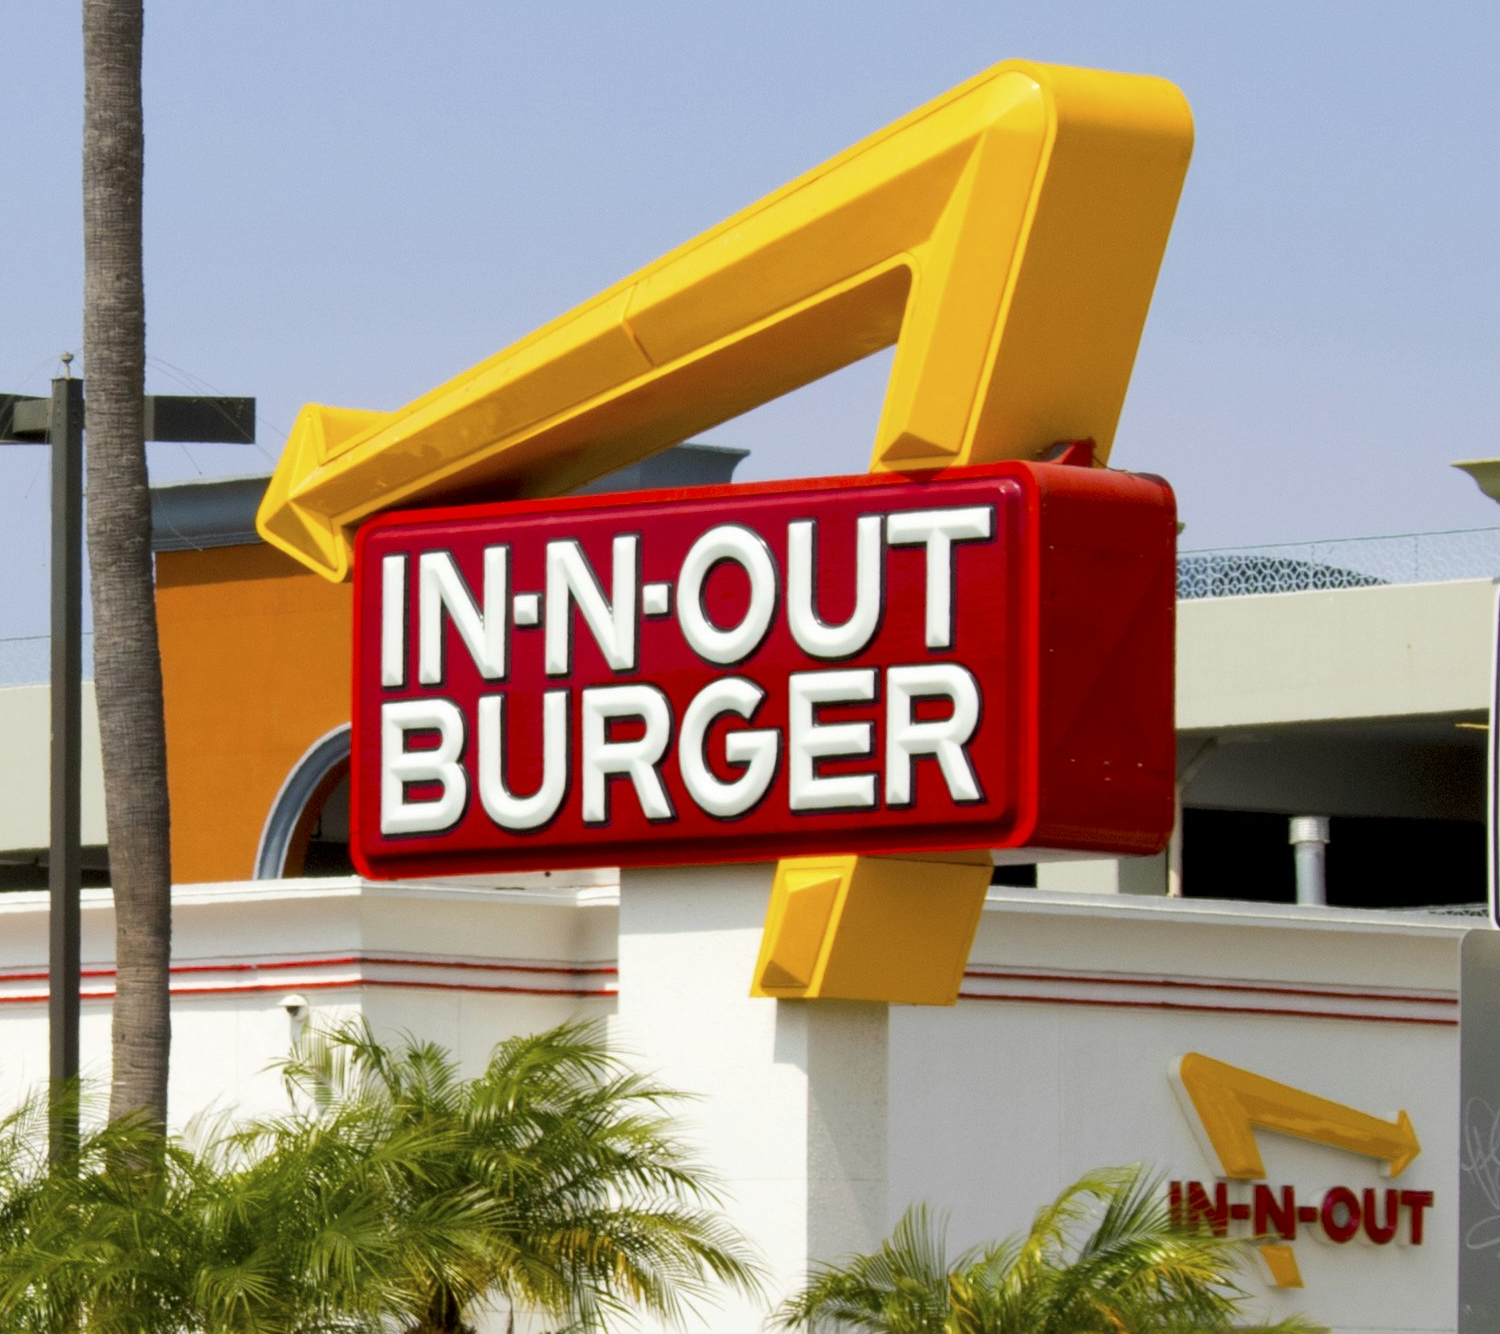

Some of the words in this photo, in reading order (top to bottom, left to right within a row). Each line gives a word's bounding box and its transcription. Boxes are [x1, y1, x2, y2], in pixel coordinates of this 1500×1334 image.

[380, 505, 996, 690] IN-N-OUT
[380, 662, 983, 838] BURGER
[1168, 1180, 1435, 1245] IN-N-OUT
